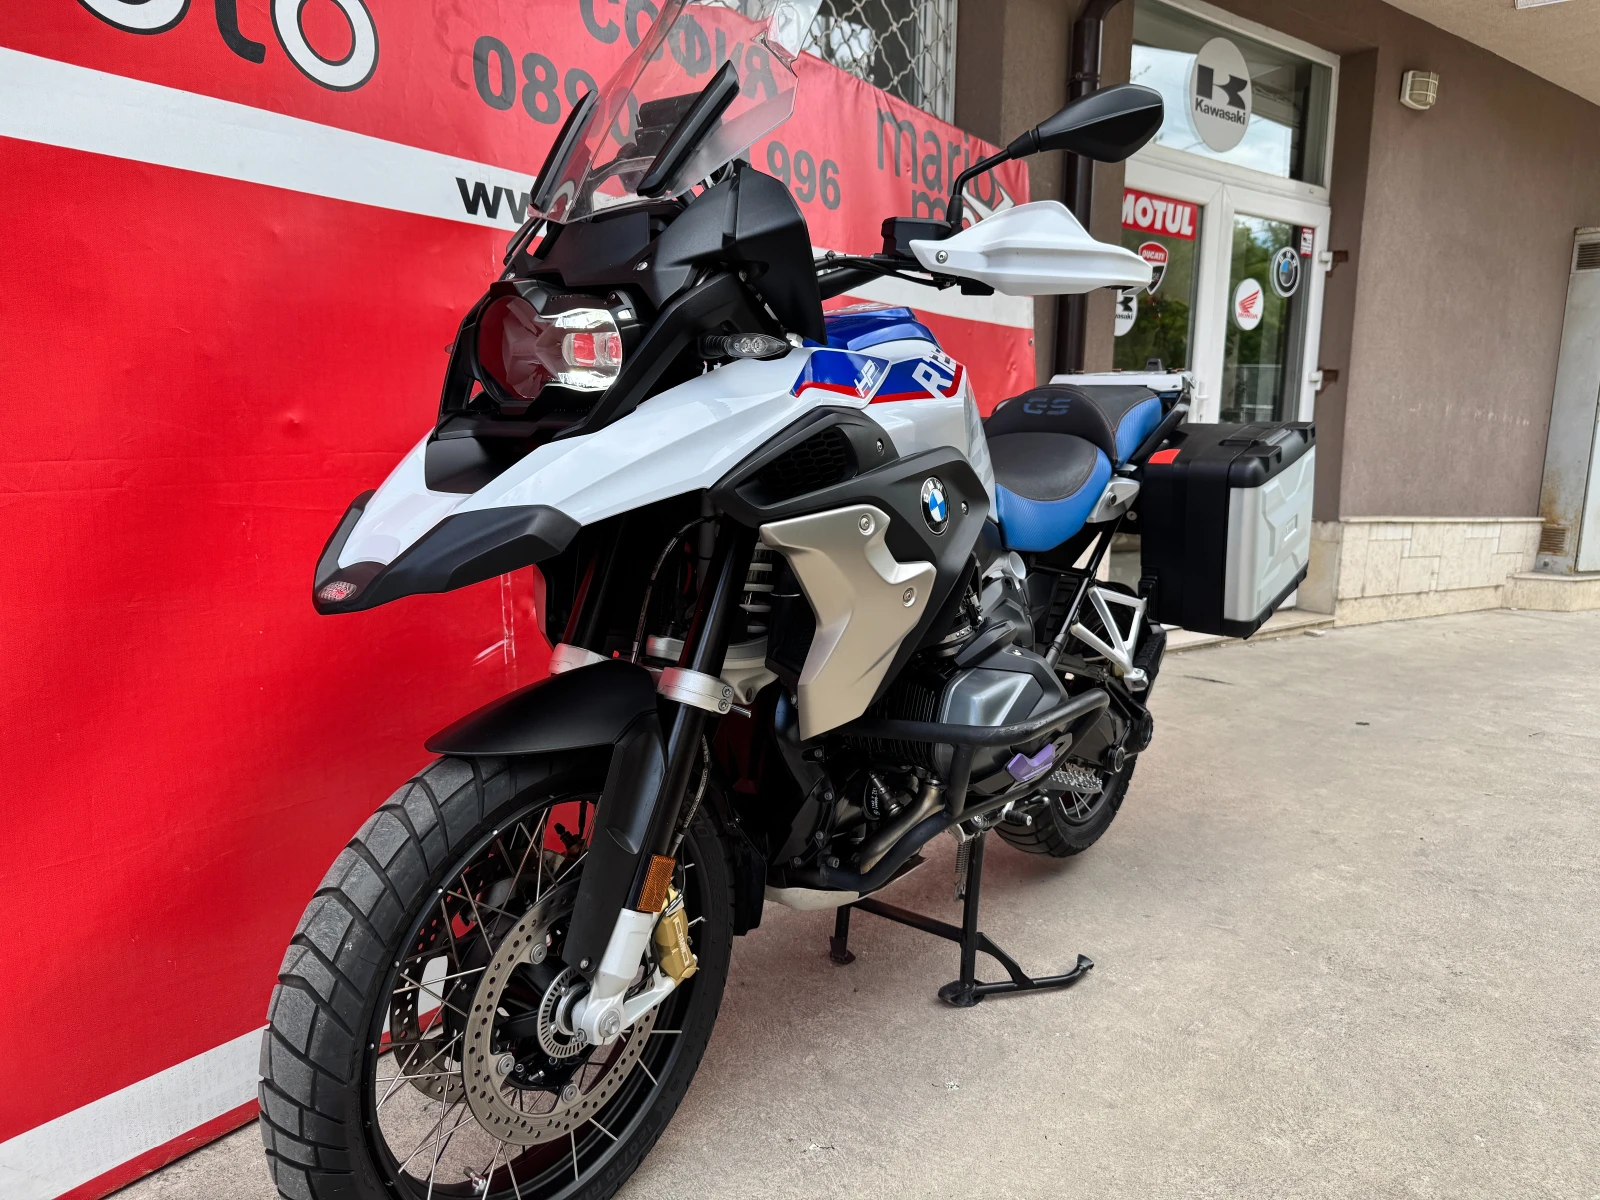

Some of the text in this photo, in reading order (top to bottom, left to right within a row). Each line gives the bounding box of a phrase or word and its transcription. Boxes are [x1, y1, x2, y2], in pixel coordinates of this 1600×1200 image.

[1195, 97, 1246, 125] Kawasaki
[767, 140, 841, 210] 996
[1122, 193, 1193, 236] MOTUL
[1141, 249, 1165, 261] DUCATI
[854, 359, 880, 398] HP
[1023, 397, 1071, 415] GS
